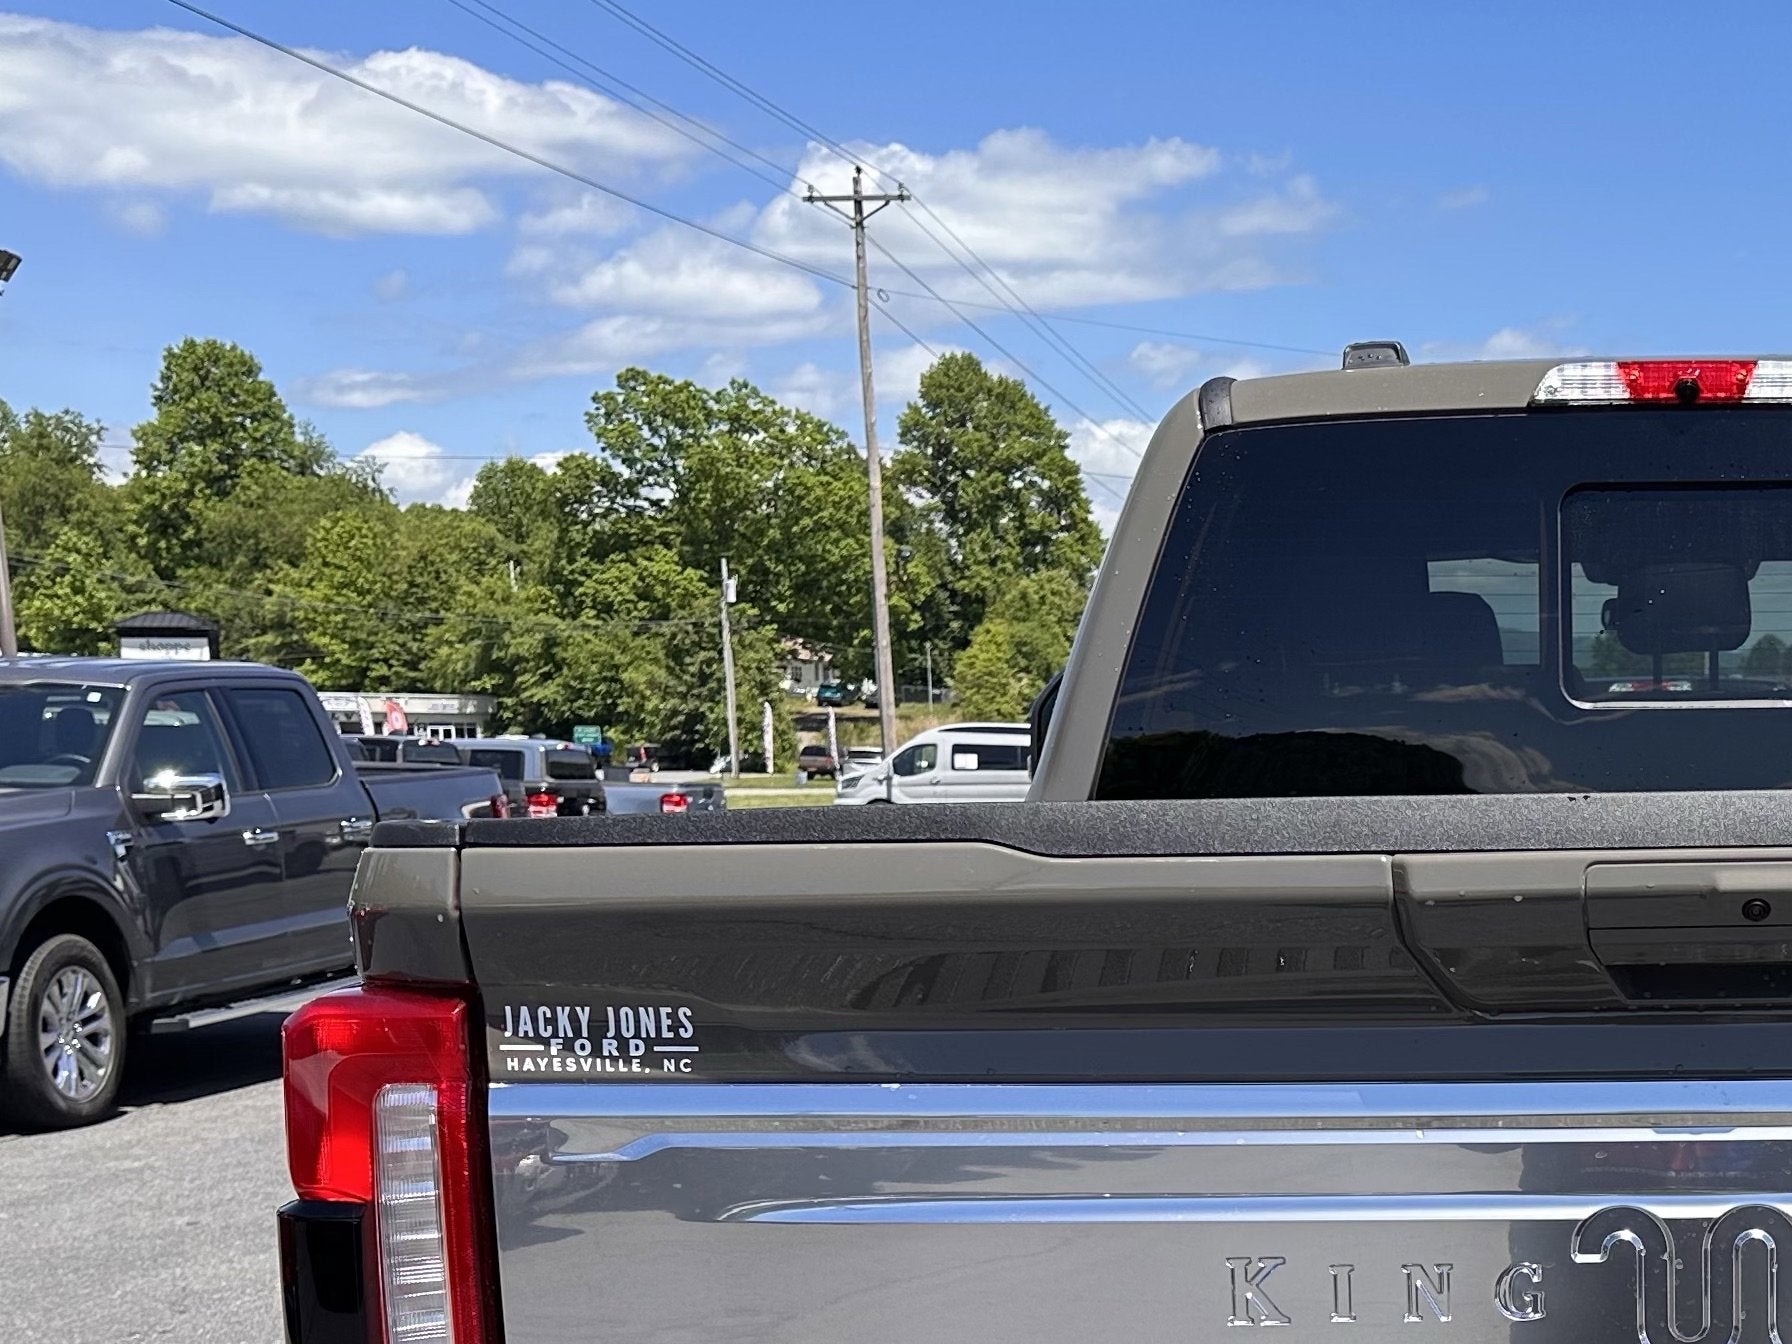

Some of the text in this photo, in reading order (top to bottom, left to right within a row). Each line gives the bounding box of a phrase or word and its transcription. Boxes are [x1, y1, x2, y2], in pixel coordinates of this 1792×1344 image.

[504, 1006, 694, 1039] JACKY JONES
[550, 1038, 646, 1057] FORD
[506, 1057, 692, 1073] HAYESVILLE, NC
[1226, 1256, 1548, 1328] KING
